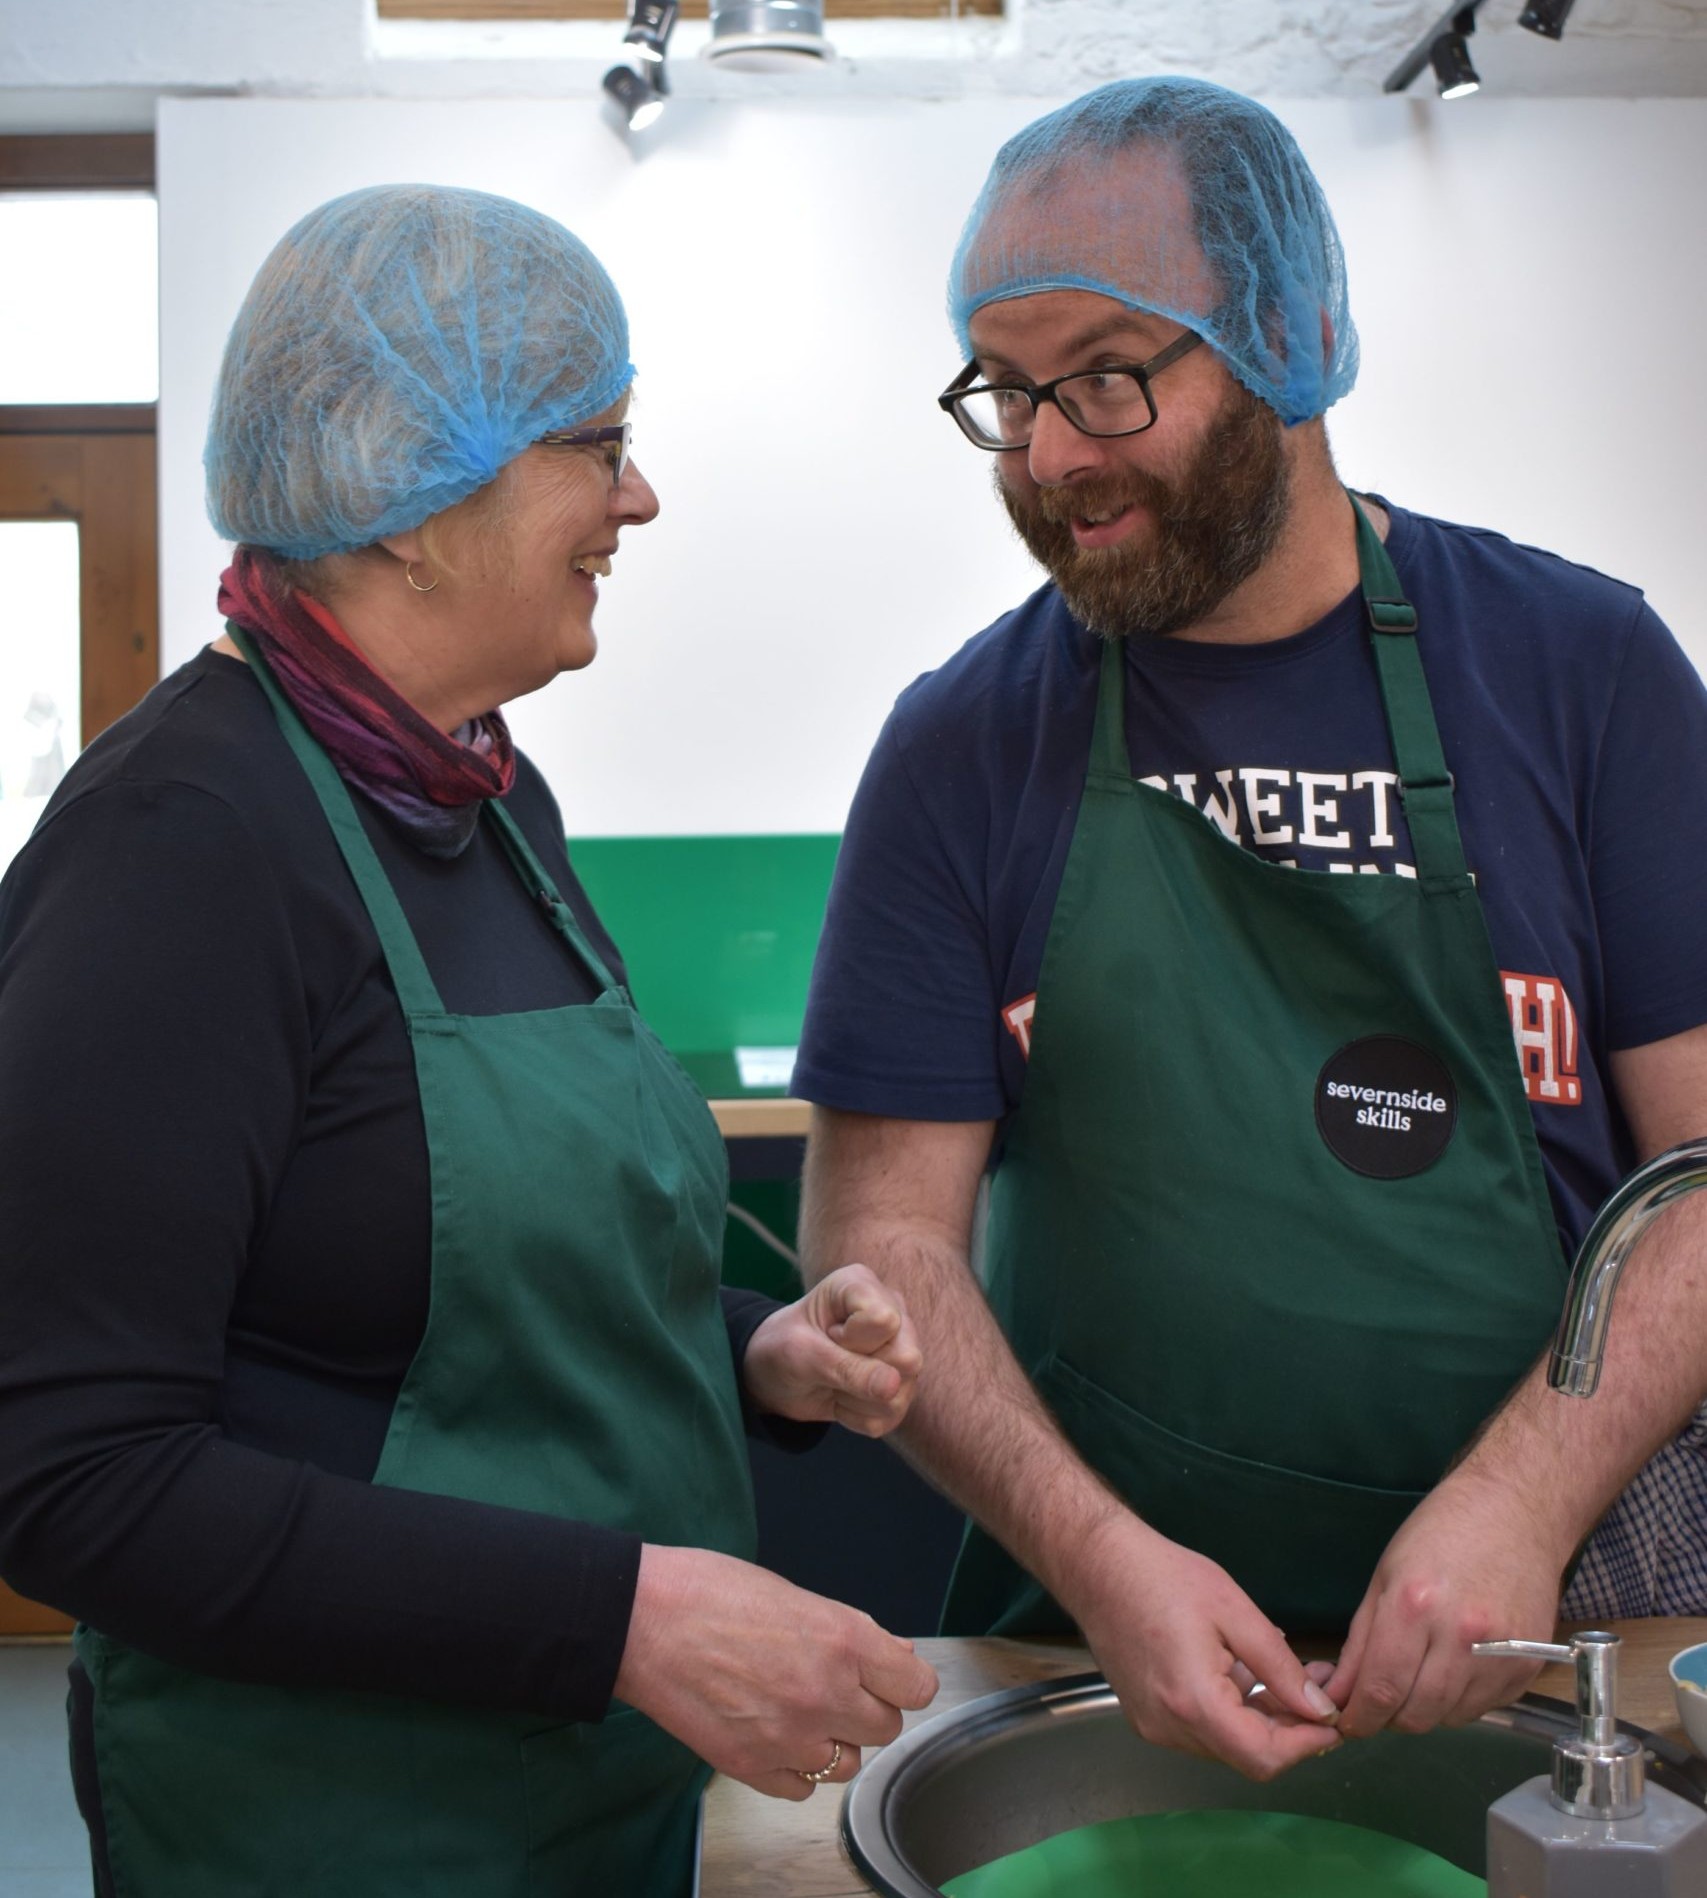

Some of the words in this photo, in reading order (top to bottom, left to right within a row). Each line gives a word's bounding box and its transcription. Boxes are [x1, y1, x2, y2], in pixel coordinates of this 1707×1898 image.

[1137, 768, 1398, 848] WEET
[1327, 1081, 1446, 1112] severnside
[1356, 1106, 1411, 1131] skills
